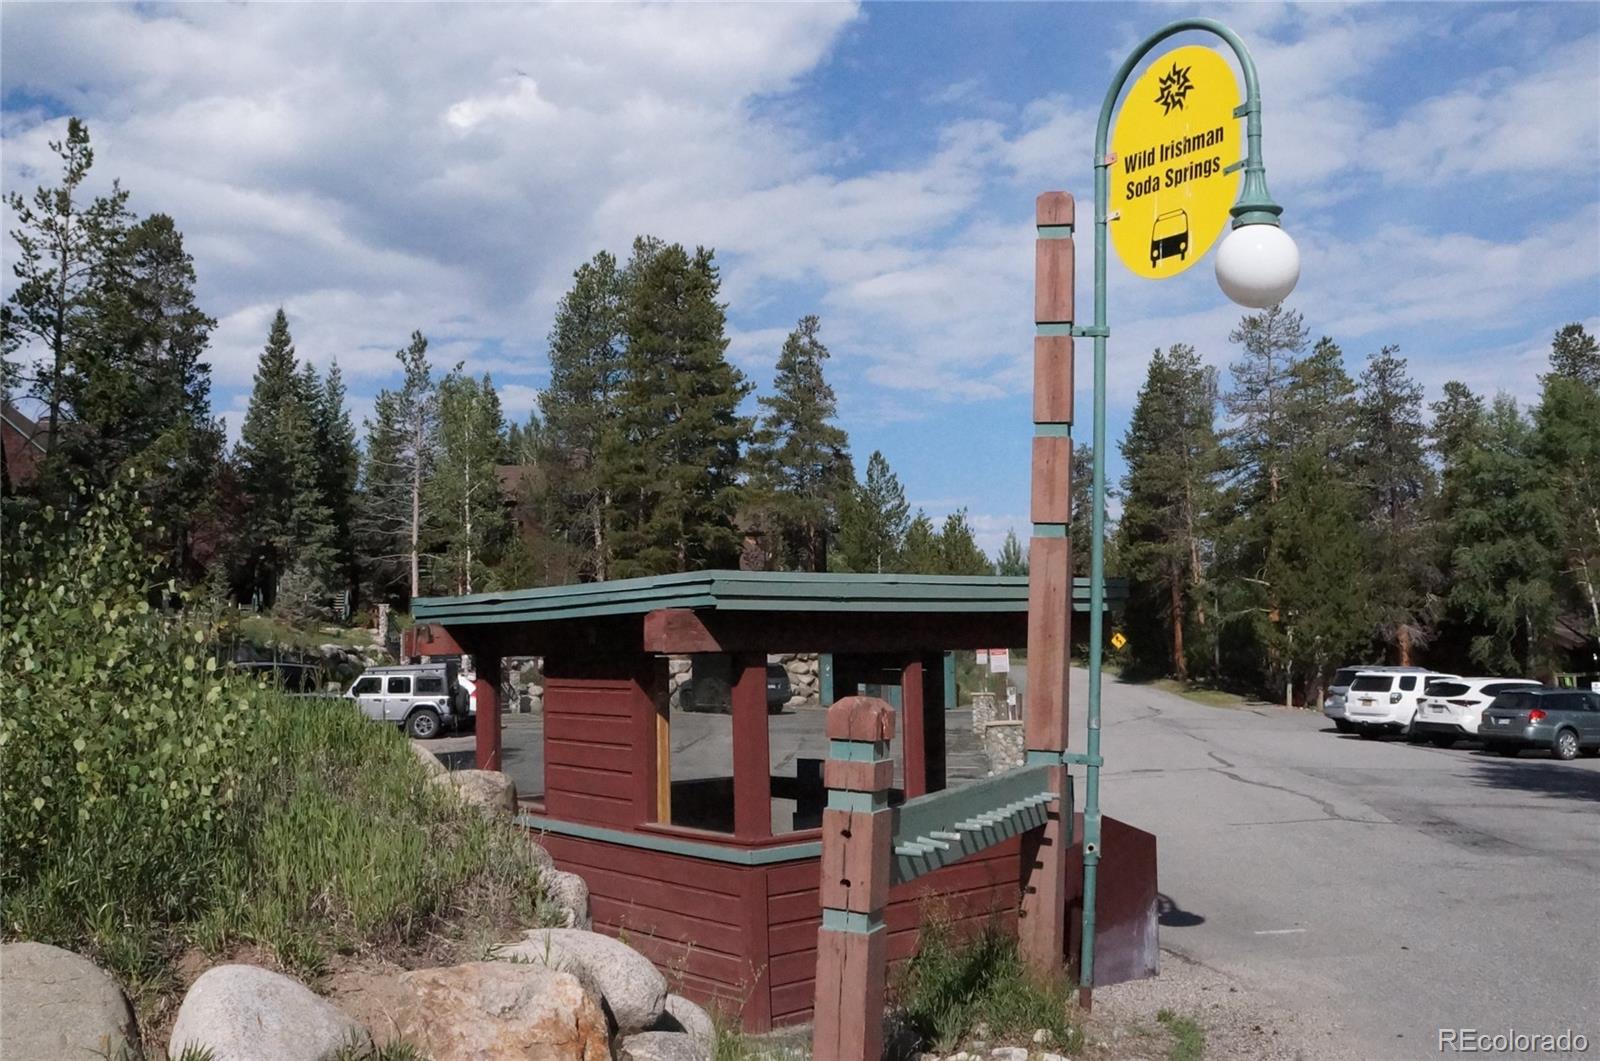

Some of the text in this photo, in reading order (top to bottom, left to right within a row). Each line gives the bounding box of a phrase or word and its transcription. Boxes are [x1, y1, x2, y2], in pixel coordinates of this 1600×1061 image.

[1124, 127, 1224, 174] Wild Irishman
[1126, 156, 1220, 200] Soda Springs
